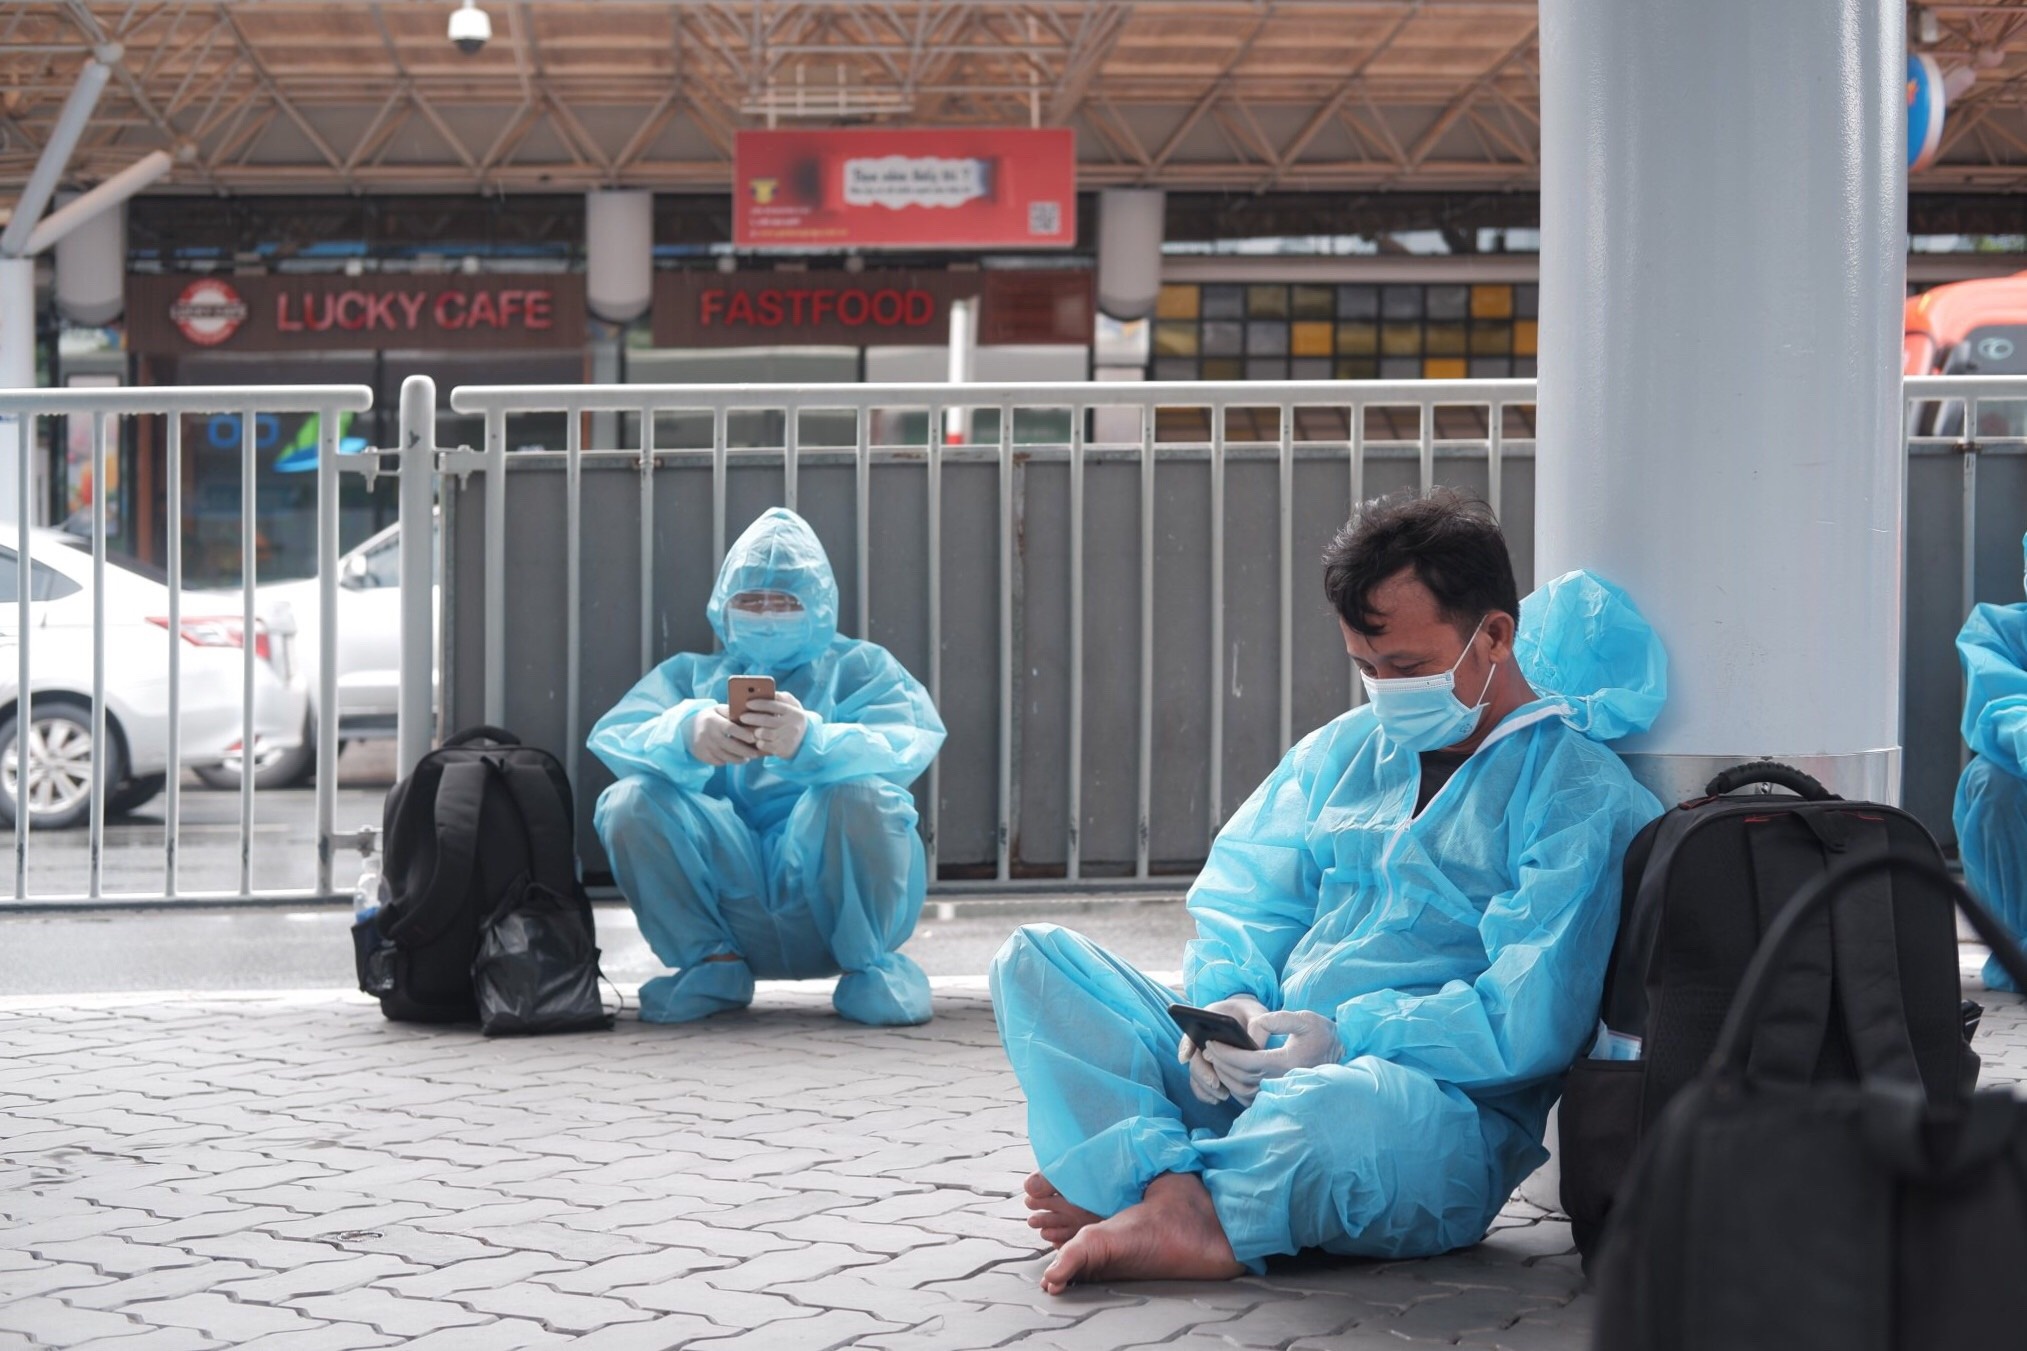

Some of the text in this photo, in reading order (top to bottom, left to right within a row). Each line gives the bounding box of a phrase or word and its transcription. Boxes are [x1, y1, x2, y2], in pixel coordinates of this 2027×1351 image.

[276, 291, 426, 331] LUCKY
[433, 290, 553, 330] CAFE
[700, 288, 935, 327] FASTFOOD
